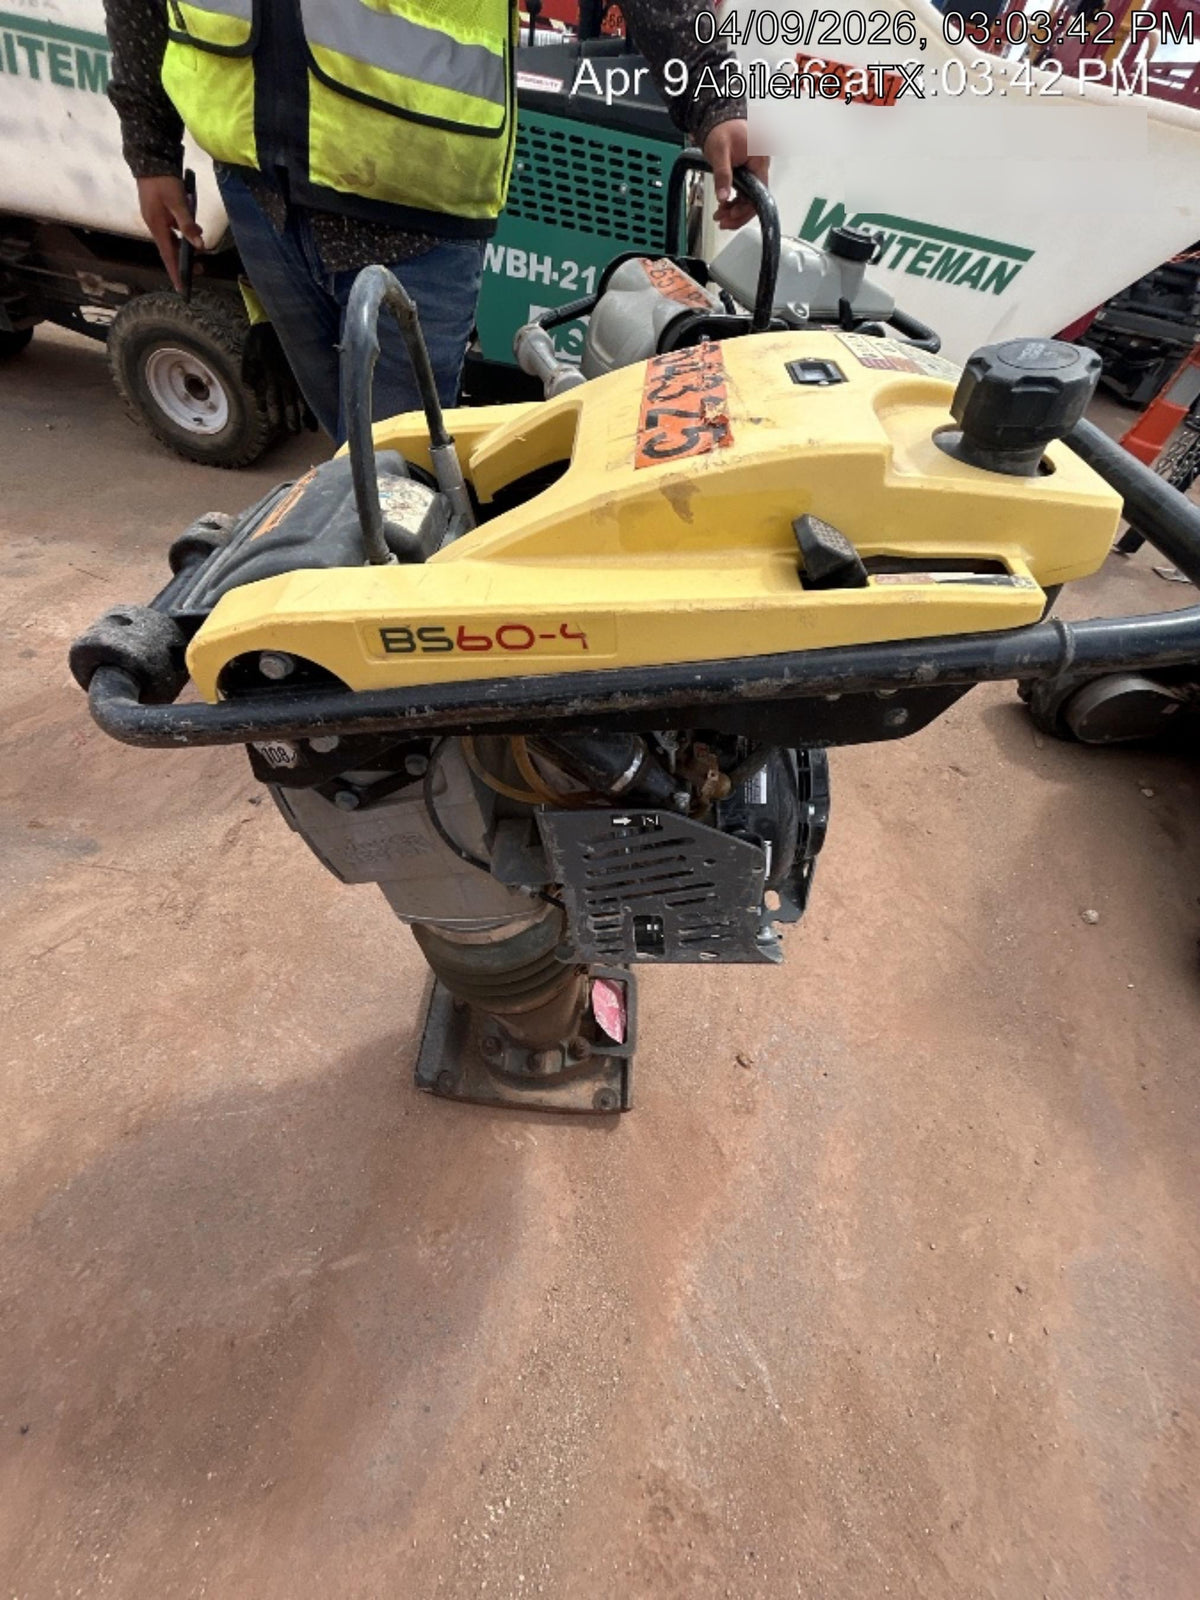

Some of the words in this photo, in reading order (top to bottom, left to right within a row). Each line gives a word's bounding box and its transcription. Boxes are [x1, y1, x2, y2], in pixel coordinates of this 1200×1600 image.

[0, 32, 108, 95] ITEM
[483, 242, 605, 294] WBH-21
[798, 196, 1037, 296] WITEMAN
[379, 623, 588, 653] BS60-4
